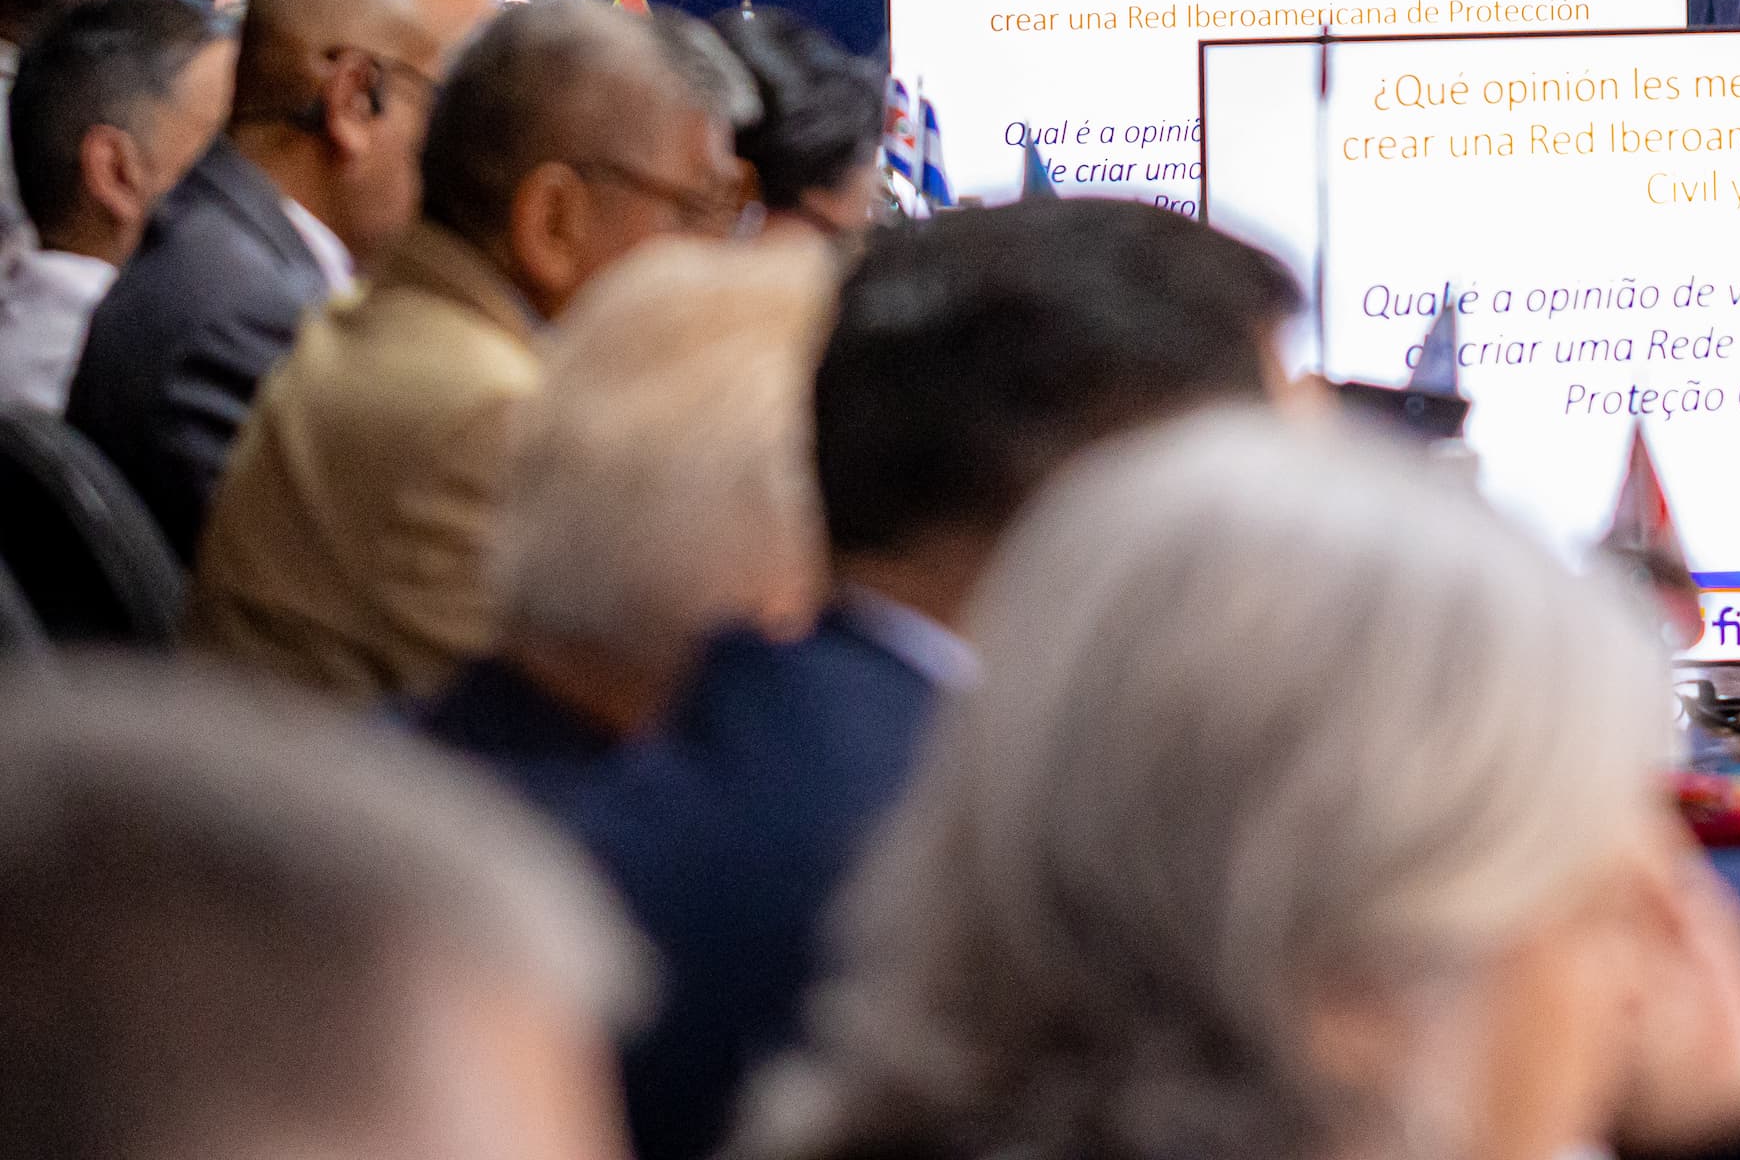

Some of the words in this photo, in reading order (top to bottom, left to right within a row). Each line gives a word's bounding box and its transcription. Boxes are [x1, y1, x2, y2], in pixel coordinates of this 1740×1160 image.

[990, 13, 1059, 32] crear
[1069, 12, 1117, 30] una
[1129, 4, 1177, 29] Red
[1188, 3, 1397, 30] Iberoamericana
[1407, 0, 1439, 24] de
[1374, 72, 1469, 111] ¿Qué
[1483, 69, 1619, 112] opinión
[1633, 67, 1680, 100] les
[1076, 120, 1090, 144] é
[1101, 126, 1115, 143] a
[1343, 136, 1435, 161] crear
[1450, 133, 1514, 158] una
[1530, 121, 1594, 155] Red
[1076, 159, 1137, 182] criar
[1647, 169, 1717, 205] Civil
[1458, 281, 1479, 314] é
[1493, 290, 1512, 313] a
[1526, 278, 1659, 320] opinião
[1672, 275, 1715, 311] de
[1458, 334, 1543, 367] criar
[1555, 338, 1633, 363] uma
[1647, 326, 1733, 360] Rede
[1567, 380, 1724, 419] Proteção
